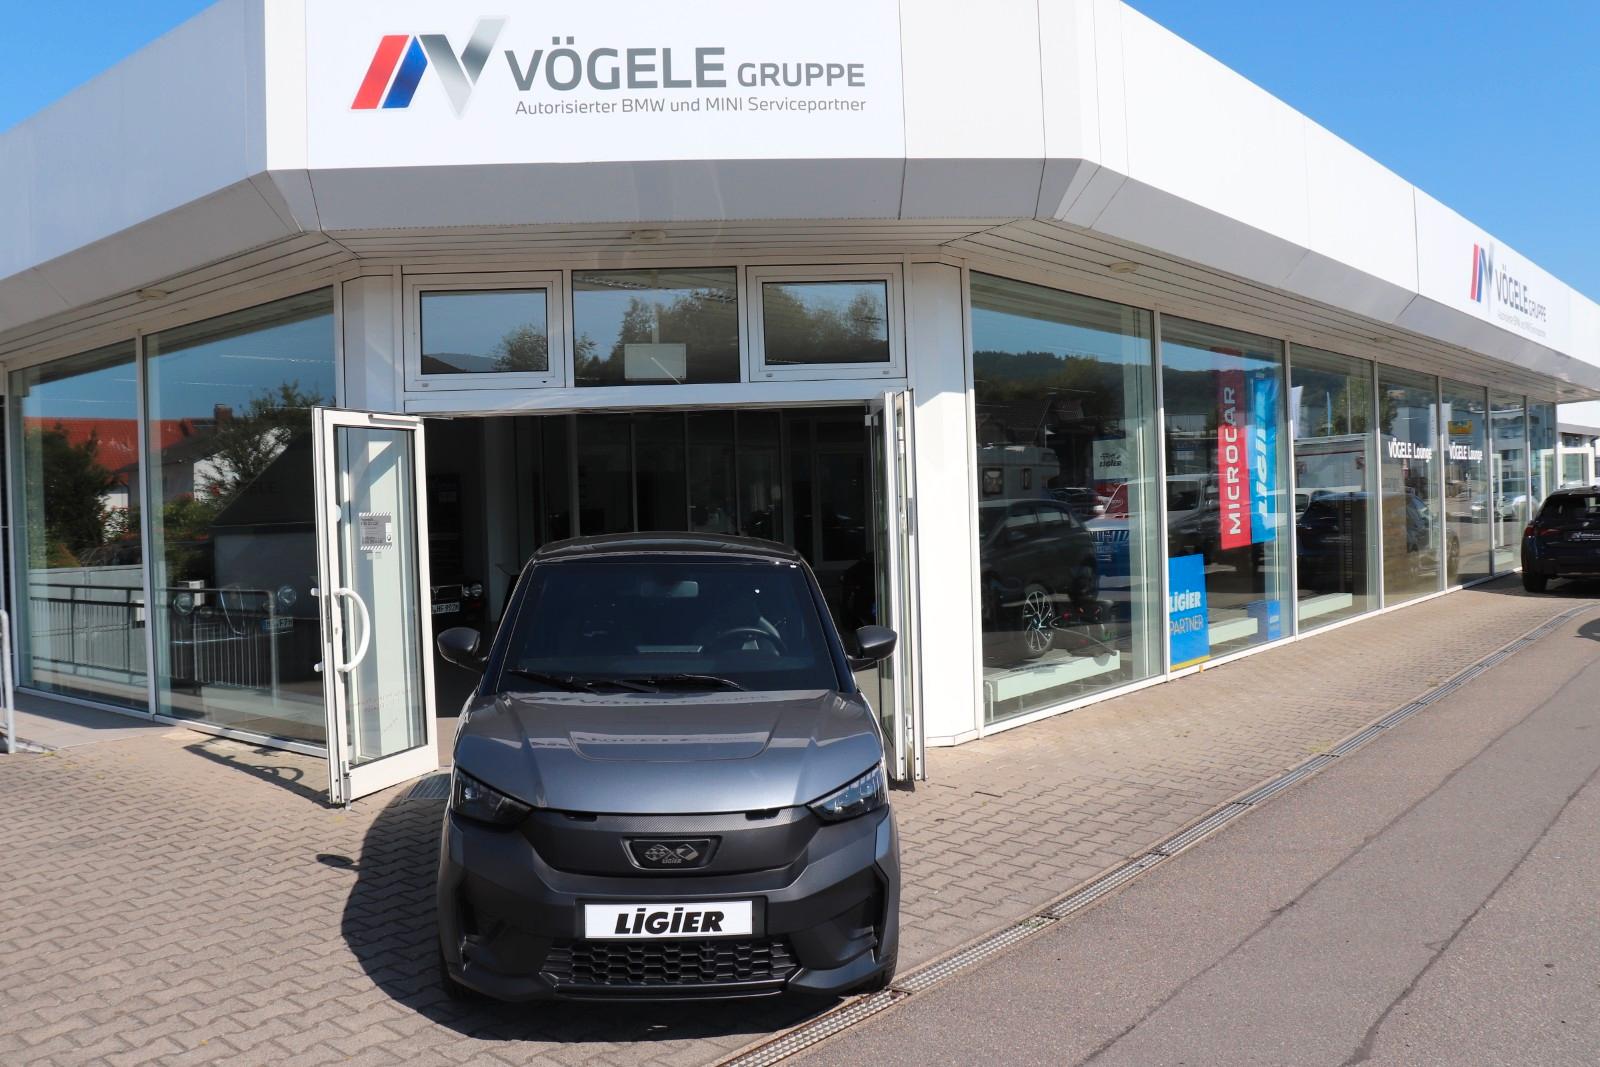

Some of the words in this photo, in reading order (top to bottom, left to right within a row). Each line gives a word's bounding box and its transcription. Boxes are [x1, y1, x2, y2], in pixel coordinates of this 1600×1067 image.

[504, 36, 727, 91] VÖGELE
[737, 62, 866, 88] GRUPPE
[515, 99, 618, 115] Autorisierter
[622, 98, 665, 113] BMW
[670, 98, 700, 112] und
[706, 97, 743, 111] MINI
[748, 96, 866, 113] Servicepartner
[1495, 264, 1528, 315] VÖGELE
[1223, 386, 1241, 535] MICROCAR
[1388, 437, 1412, 459] VÖGELE
